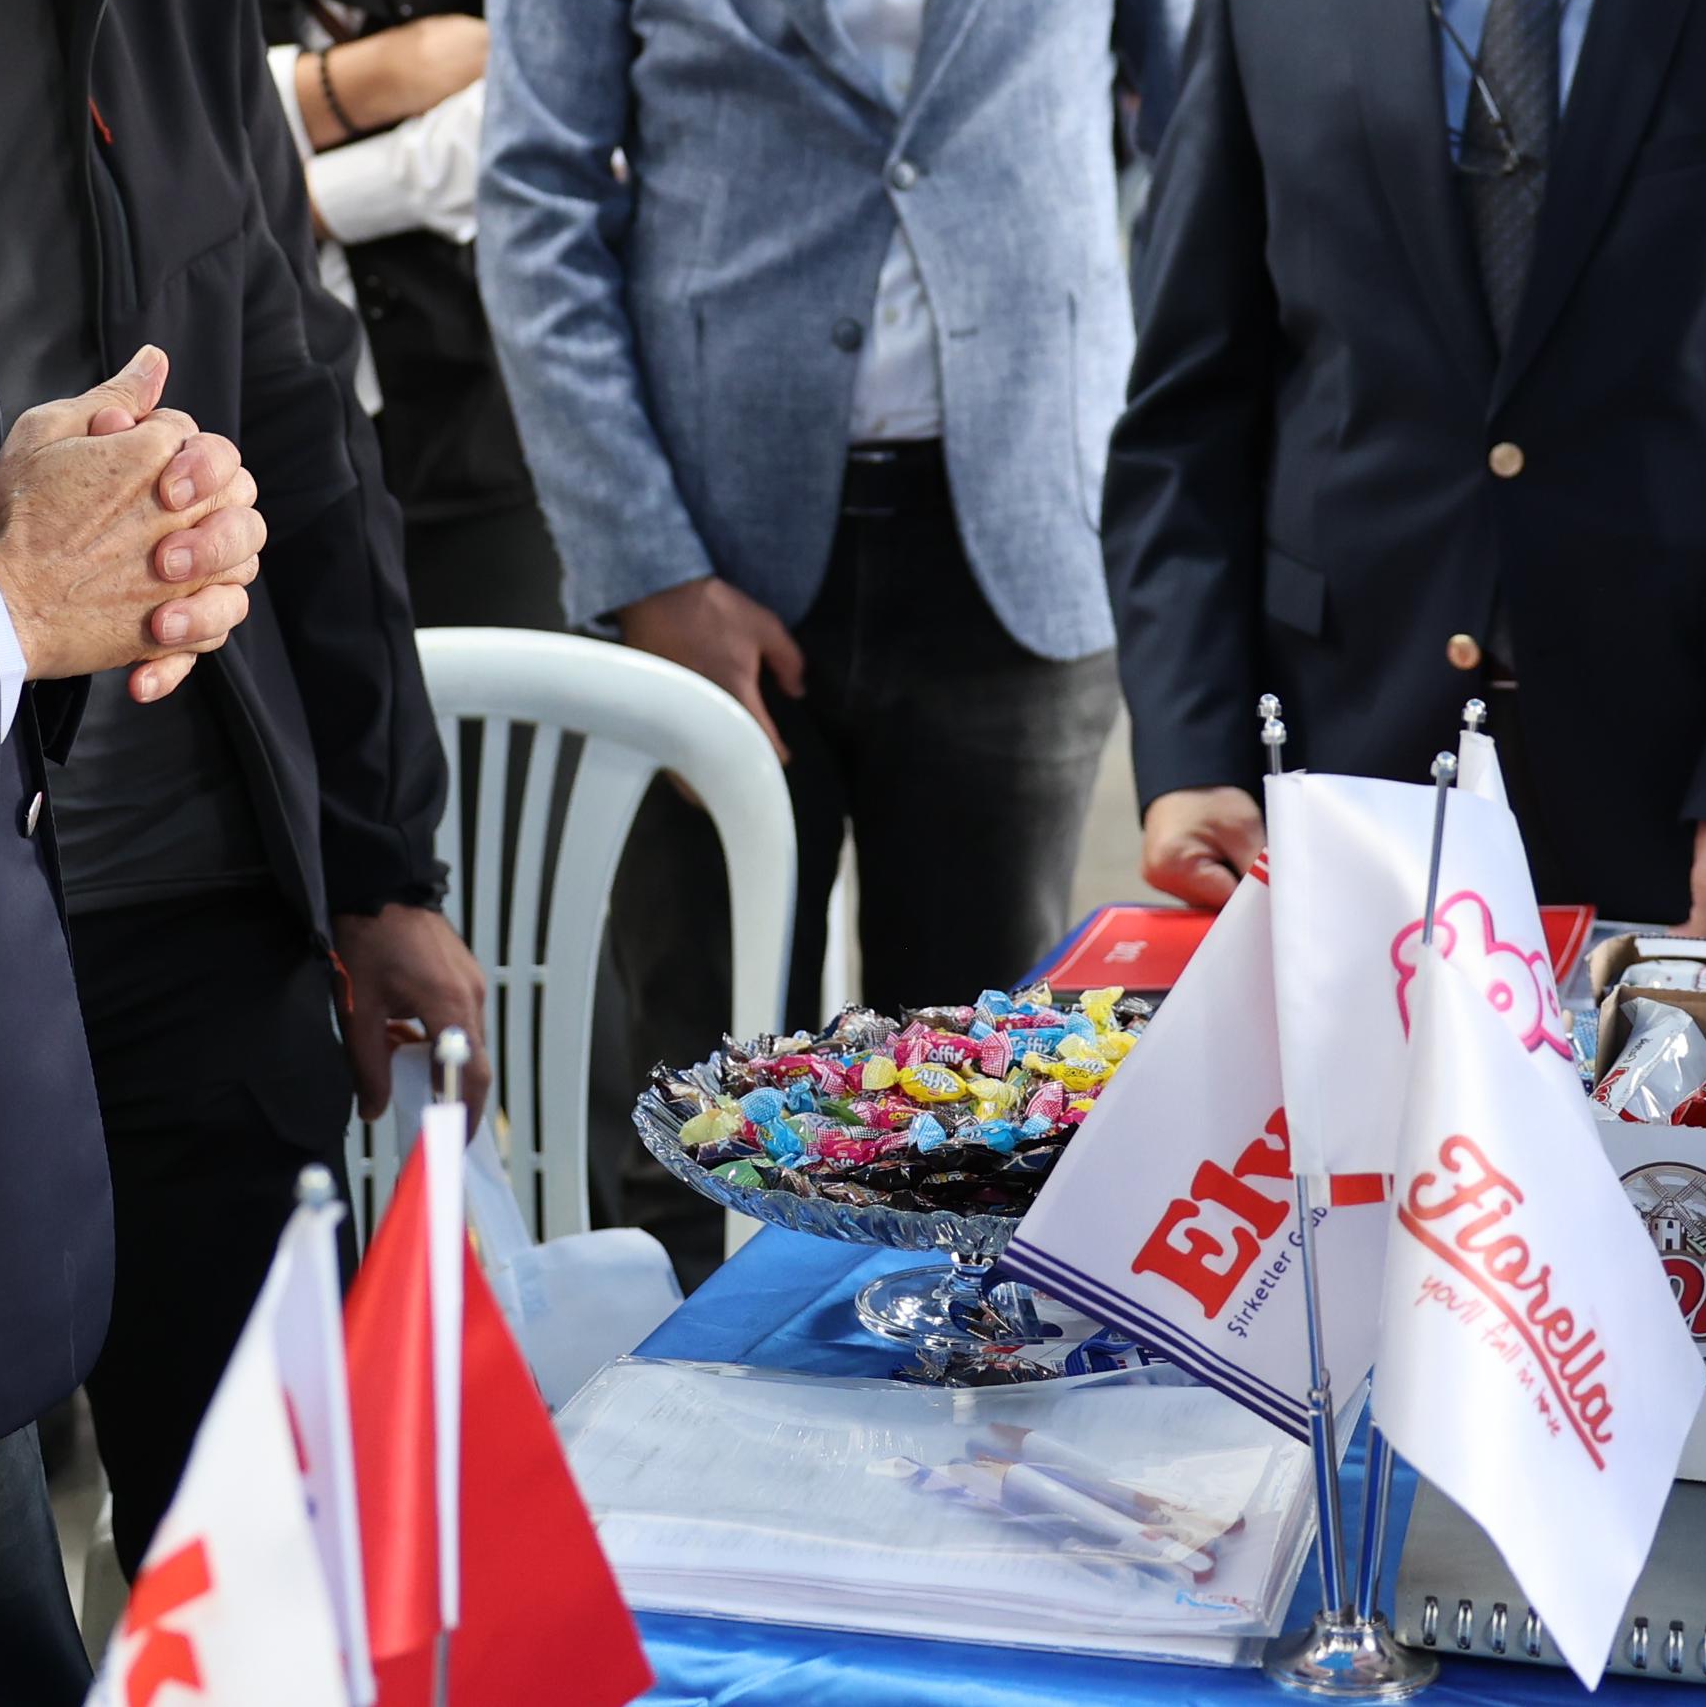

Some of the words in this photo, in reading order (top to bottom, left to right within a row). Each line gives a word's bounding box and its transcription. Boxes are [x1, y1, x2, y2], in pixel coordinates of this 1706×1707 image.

[928, 1044, 966, 1064] offix
[1227, 1250, 1292, 1338] Şirketler
[1407, 1134, 1614, 1443] Fiorella
